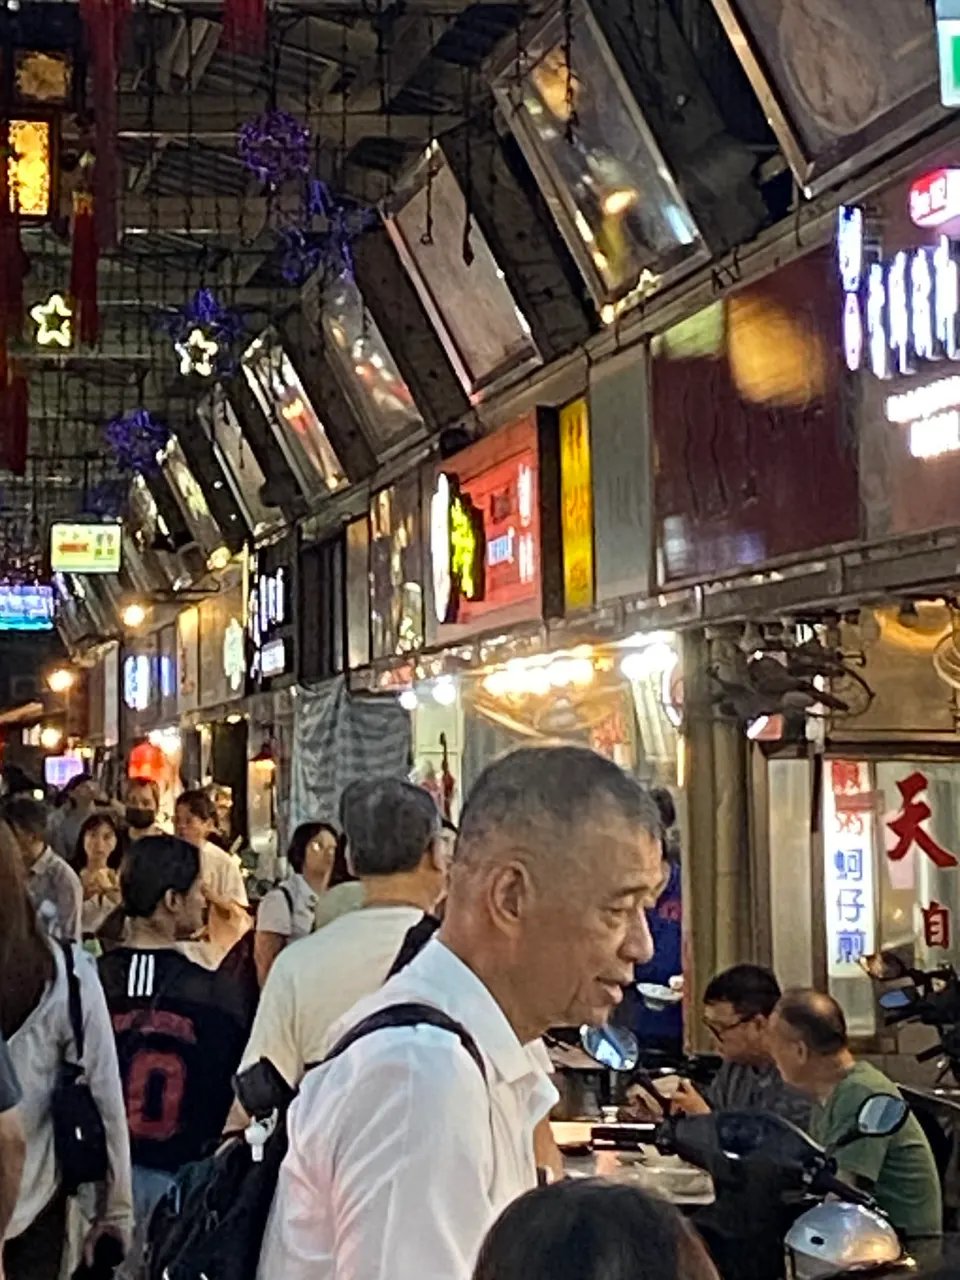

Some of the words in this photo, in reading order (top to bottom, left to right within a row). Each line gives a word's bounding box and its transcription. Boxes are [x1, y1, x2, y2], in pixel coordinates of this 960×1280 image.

[886, 771, 959, 867] 天
[834, 848, 866, 964] 蚵仔煎
